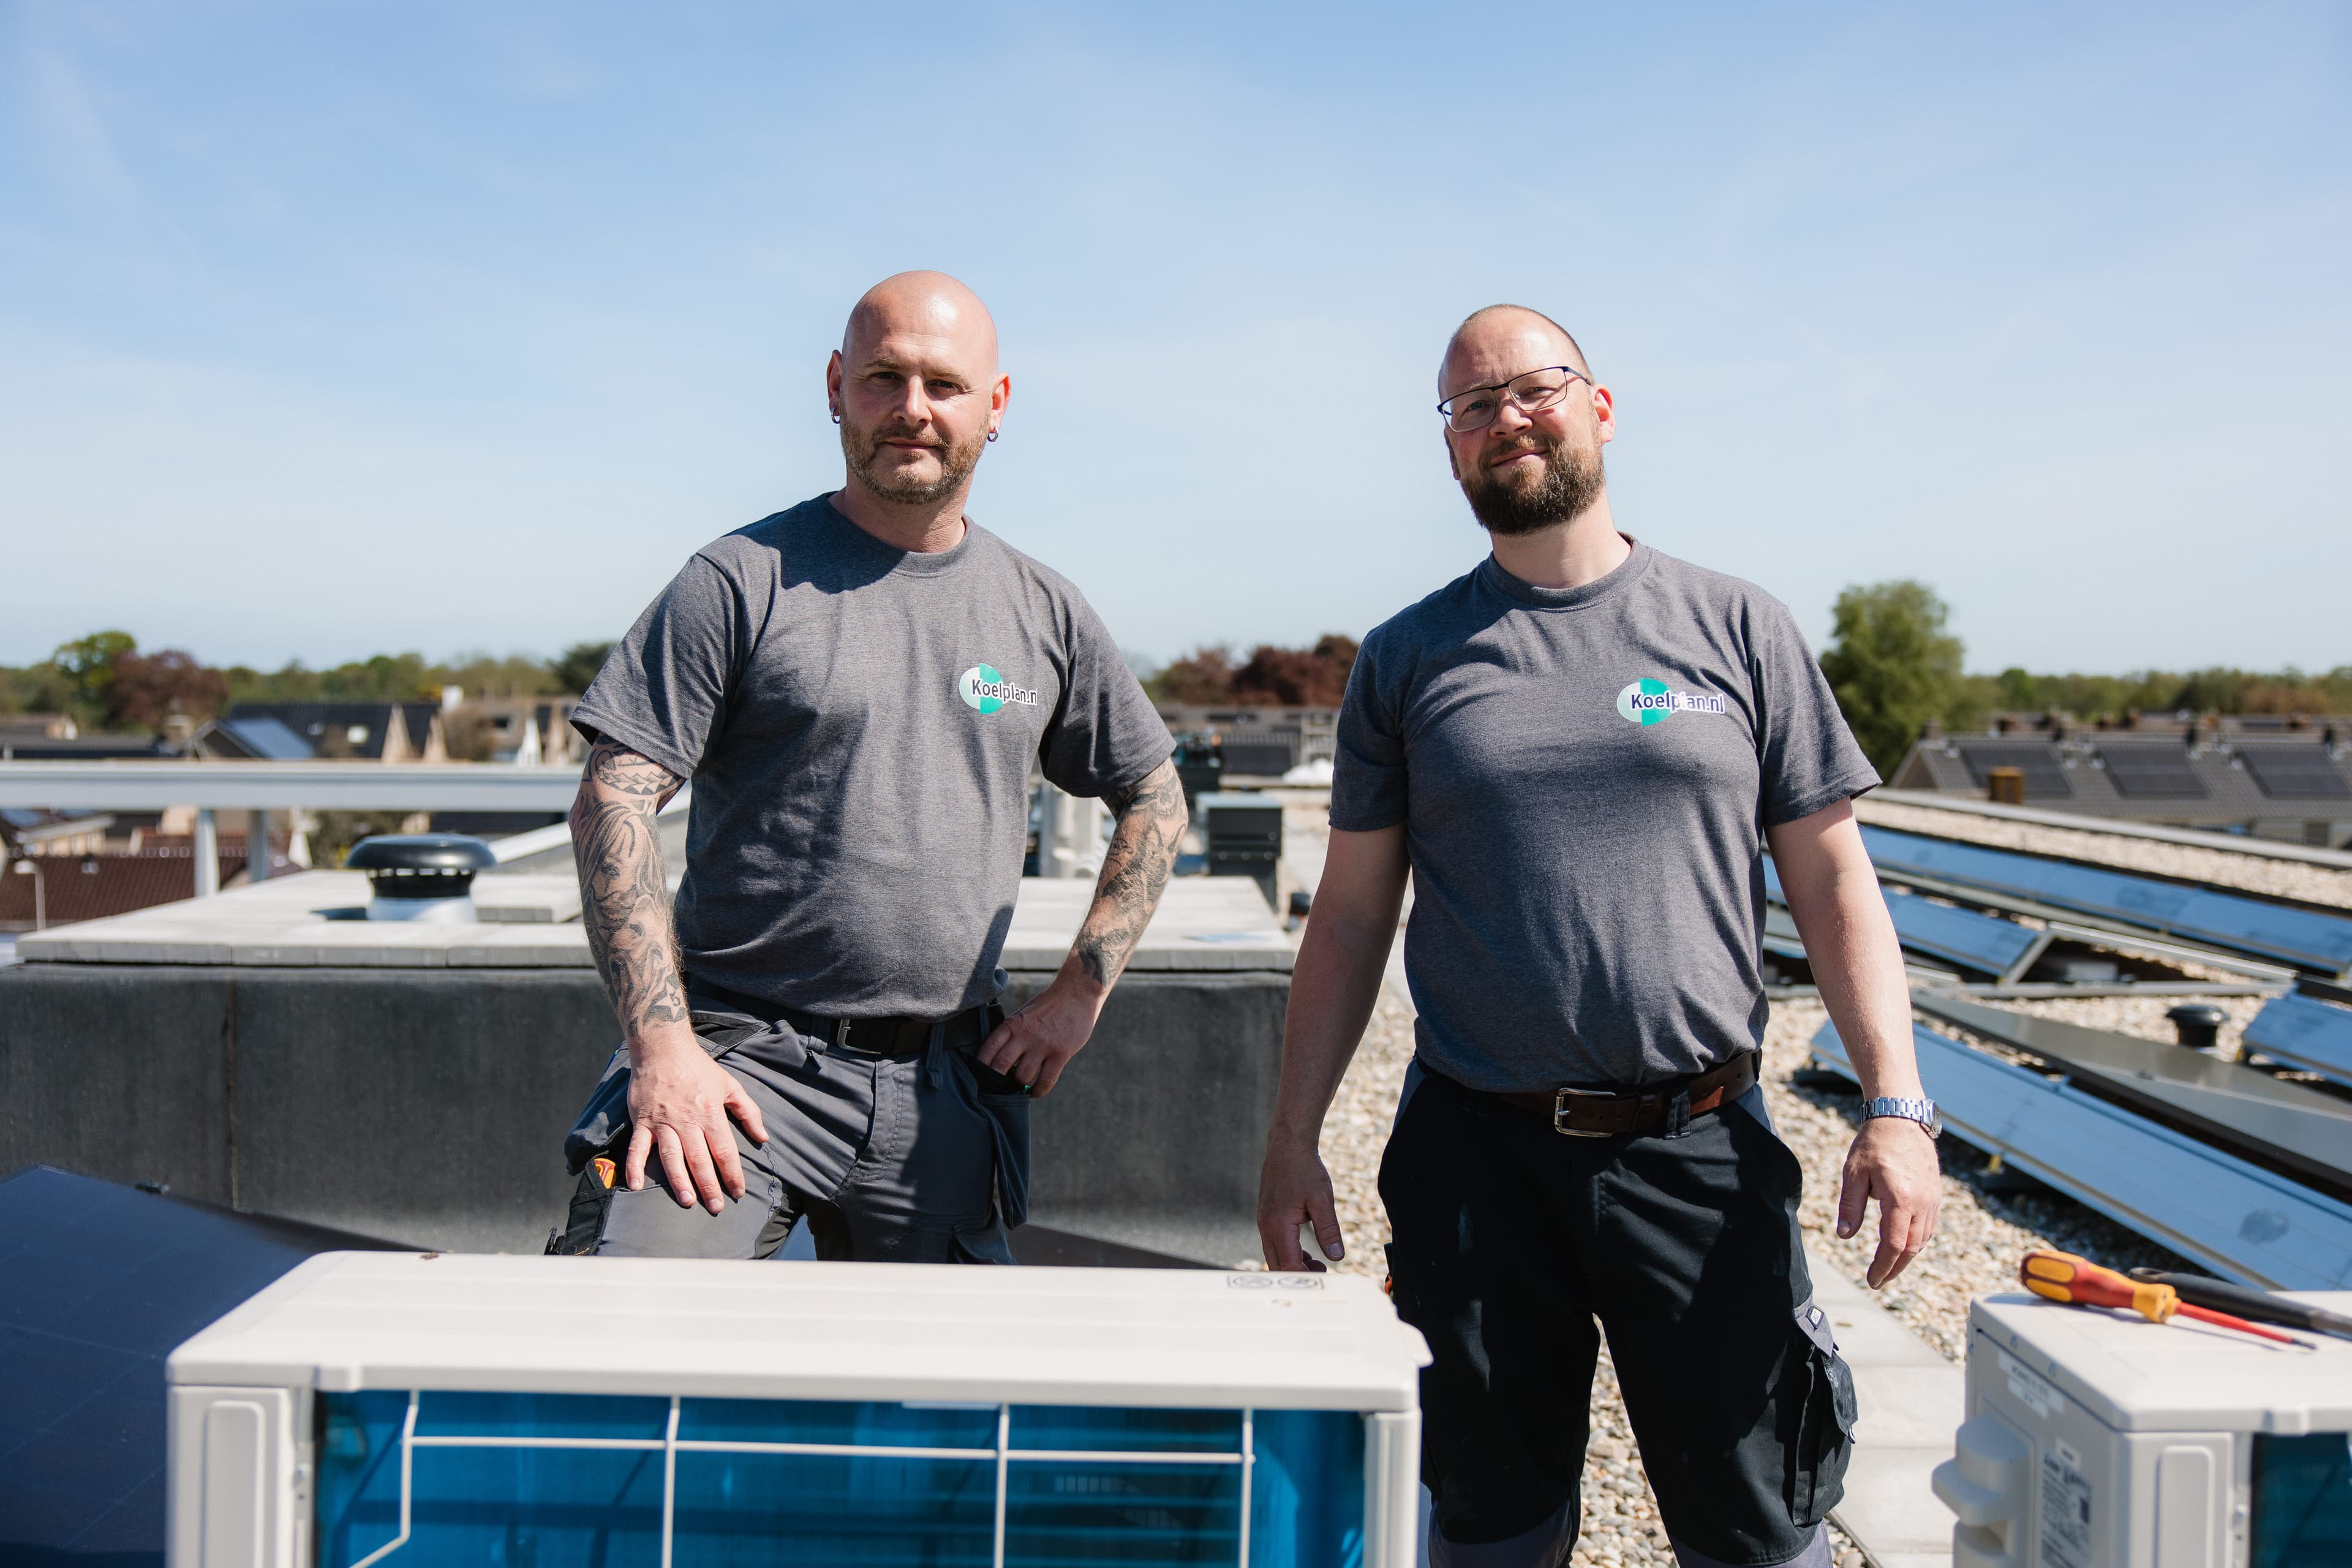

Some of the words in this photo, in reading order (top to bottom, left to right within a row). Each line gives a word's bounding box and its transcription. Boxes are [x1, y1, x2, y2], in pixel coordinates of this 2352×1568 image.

[972, 679, 1037, 704] Koelplan.n
[1631, 692, 1724, 712] Koelpan.nl
[669, 992, 680, 1006] 5
